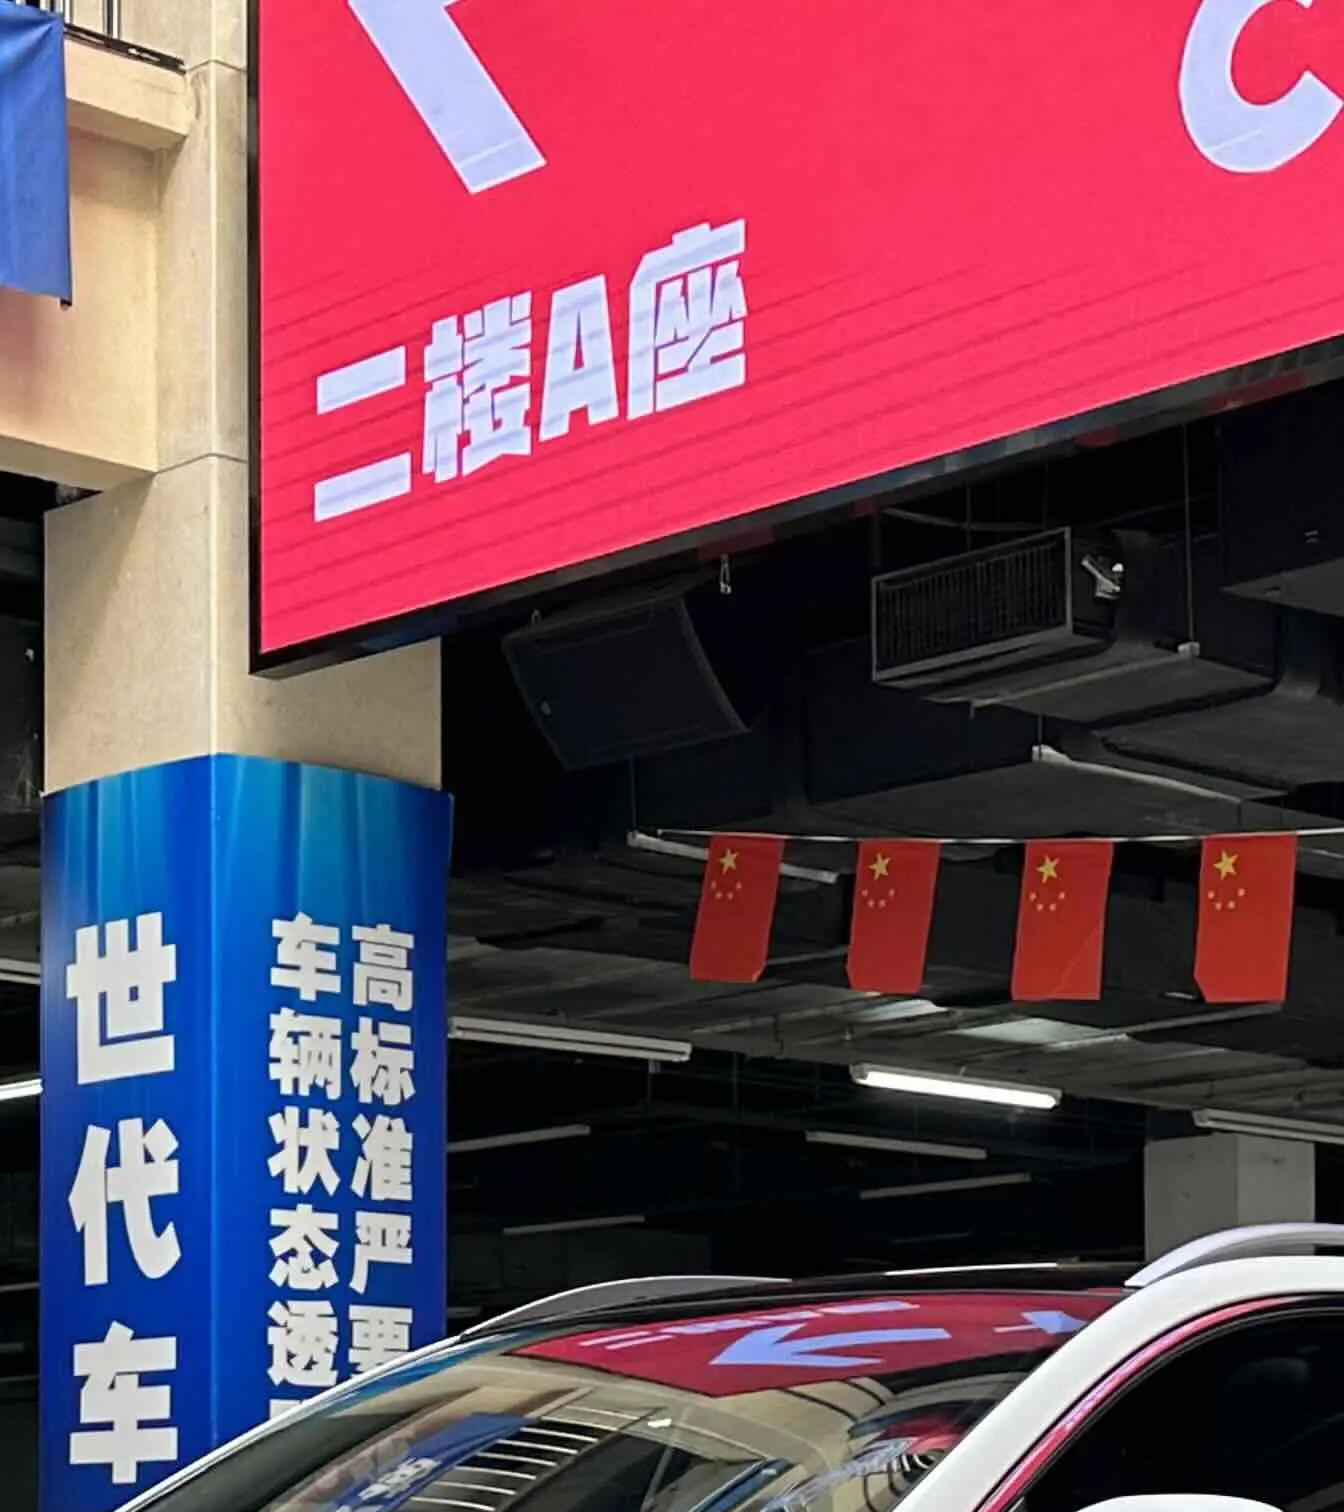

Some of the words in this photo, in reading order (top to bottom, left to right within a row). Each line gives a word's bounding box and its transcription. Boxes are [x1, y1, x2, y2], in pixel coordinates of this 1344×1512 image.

[314, 219, 748, 522] 二楼A座
[267, 911, 342, 1424] 车辆状态透
